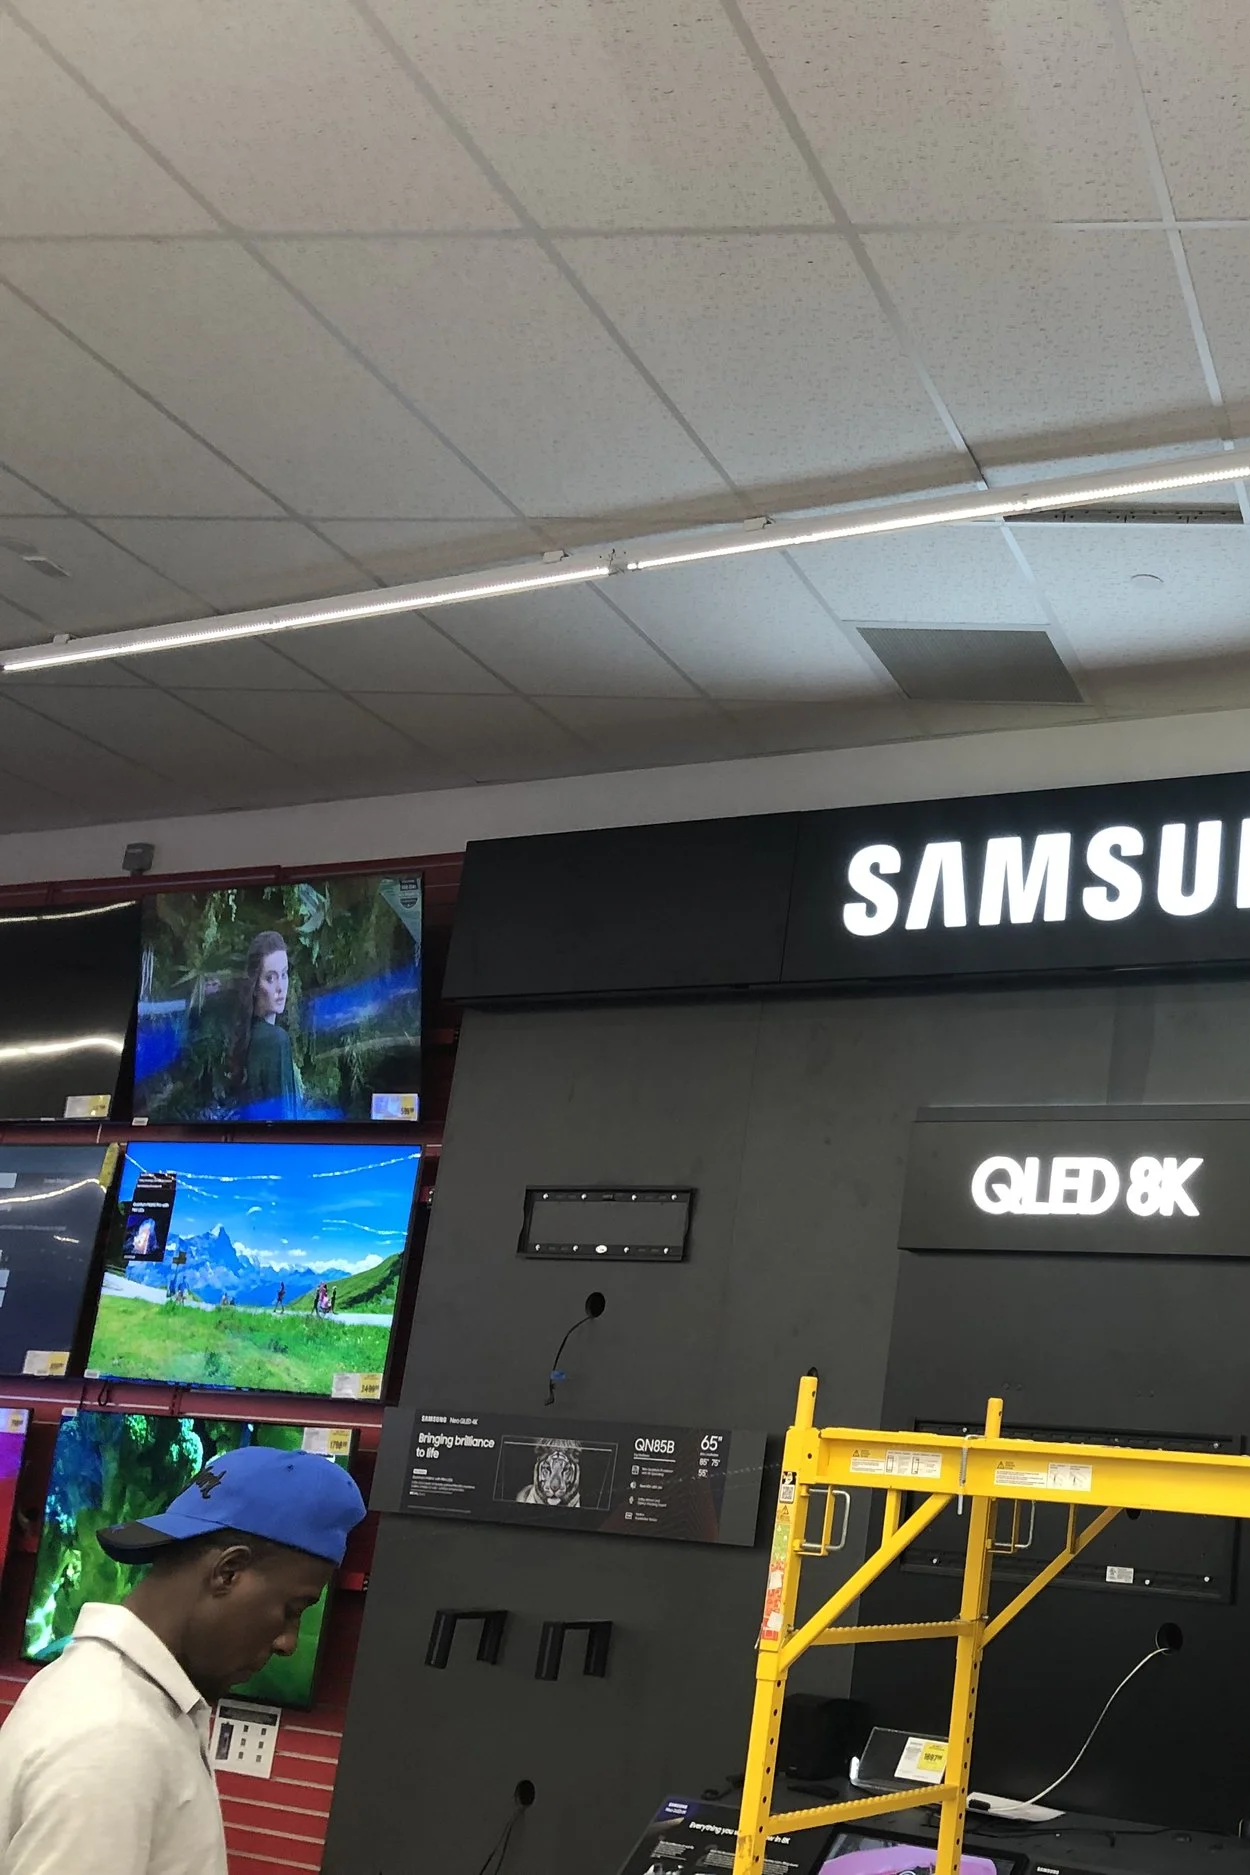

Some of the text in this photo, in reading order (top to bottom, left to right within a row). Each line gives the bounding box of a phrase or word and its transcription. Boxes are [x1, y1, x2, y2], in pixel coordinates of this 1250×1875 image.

[971, 1155, 1204, 1217] QLED 8K
[421, 1415, 447, 1424] SAMSUNG
[418, 1432, 495, 1449] Bringing brilliance
[634, 1438, 675, 1454] QN85B
[700, 1435, 723, 1451] 65"
[416, 1447, 440, 1459] to life
[688, 1821, 735, 1836] Everything you
